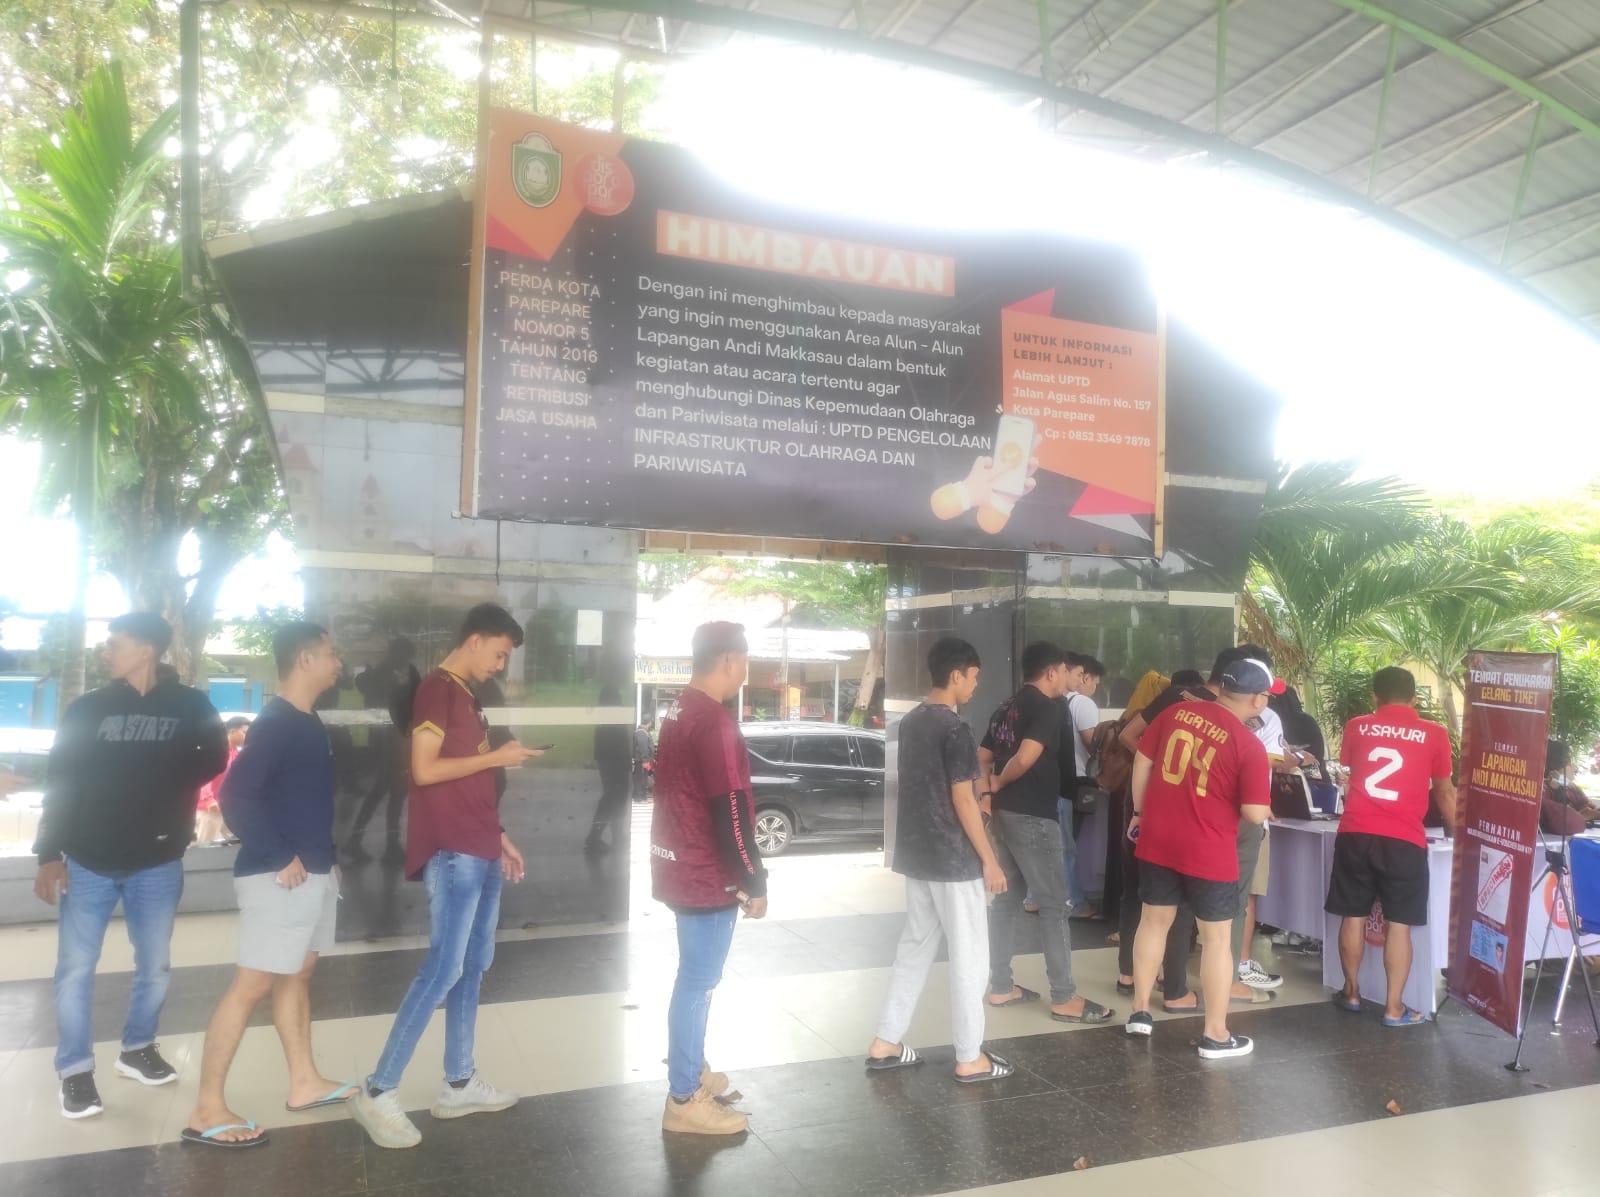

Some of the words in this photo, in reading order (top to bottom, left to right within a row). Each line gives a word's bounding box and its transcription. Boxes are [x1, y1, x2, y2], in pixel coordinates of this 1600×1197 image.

[667, 216, 944, 292] HIMBAUAN
[500, 272, 552, 290] PERDA
[558, 280, 600, 298] KOTA
[510, 296, 591, 318] PAREPARE
[639, 276, 704, 299] Dengan
[709, 286, 728, 302] ini
[732, 291, 835, 318] menghimbau
[840, 304, 894, 328] kepada
[899, 315, 982, 336] masyarakat
[514, 318, 575, 338] NOMOR
[581, 328, 590, 340] 5
[638, 305, 680, 324] yang
[684, 308, 724, 330] ingin
[729, 316, 840, 341] menggunakan
[845, 330, 880, 346] Area
[884, 334, 916, 350] Alun
[932, 340, 964, 356] Alun
[500, 339, 557, 358] TAHUN
[562, 347, 598, 364] 2016
[638, 327, 720, 351] Lapangan
[724, 338, 761, 355] Andi
[766, 343, 842, 366] Makkasau
[847, 354, 892, 370] dalam
[896, 359, 947, 377] bentuk
[1014, 332, 1057, 346] UNTUK
[1062, 339, 1132, 356] INFORMASI
[1014, 350, 1051, 363] LEBIH
[1056, 354, 1104, 368] LANJUT
[510, 363, 587, 384] TENTANG
[636, 352, 709, 376] kegiatan
[713, 363, 748, 378] atau
[752, 369, 797, 384] acara
[800, 373, 864, 392] tertentu
[867, 382, 900, 396] agar
[1013, 369, 1054, 384] Alamat
[1058, 375, 1090, 388] UPTD
[506, 386, 588, 406] RETRIBUSI
[636, 380, 752, 406] menghubungi
[758, 392, 801, 408] Dinas
[805, 397, 906, 420] Kepemudaan
[910, 407, 975, 428] Olahraga
[1012, 387, 1044, 399] Jalan
[1047, 391, 1076, 404] Agus
[1080, 394, 1111, 406] Salim
[1114, 398, 1131, 410] No.
[1134, 400, 1152, 411] 157
[496, 408, 537, 424] JASA
[542, 412, 597, 429] USAHA
[1013, 404, 1040, 416] Kota
[1044, 406, 1096, 423] Parepare
[635, 404, 667, 420] dan
[672, 407, 758, 428] Pariwisata
[762, 418, 818, 434] melalui
[830, 423, 873, 438] UPTD
[877, 428, 991, 450] PENGELOLAAN
[1044, 428, 1059, 441] Cp
[1068, 430, 1094, 442] 0852
[634, 428, 781, 455] INFRASTRUKTUR
[785, 442, 878, 463] OLAHRAGA
[882, 450, 915, 466] DAN
[634, 454, 747, 477] PARIWISATA
[1470, 670, 1502, 685] TEMPAT
[1482, 686, 1512, 702] GELANG
[1514, 690, 1538, 705] TIKET
[1175, 709, 1228, 744] AGATHA
[1359, 724, 1426, 744] Y.SAYURI
[1161, 729, 1217, 798] 04
[1364, 747, 1404, 801] 2
[1482, 752, 1526, 776] LAPANGAN
[1472, 768, 1488, 786] ANDI
[1490, 772, 1538, 798] MAKKASAU
